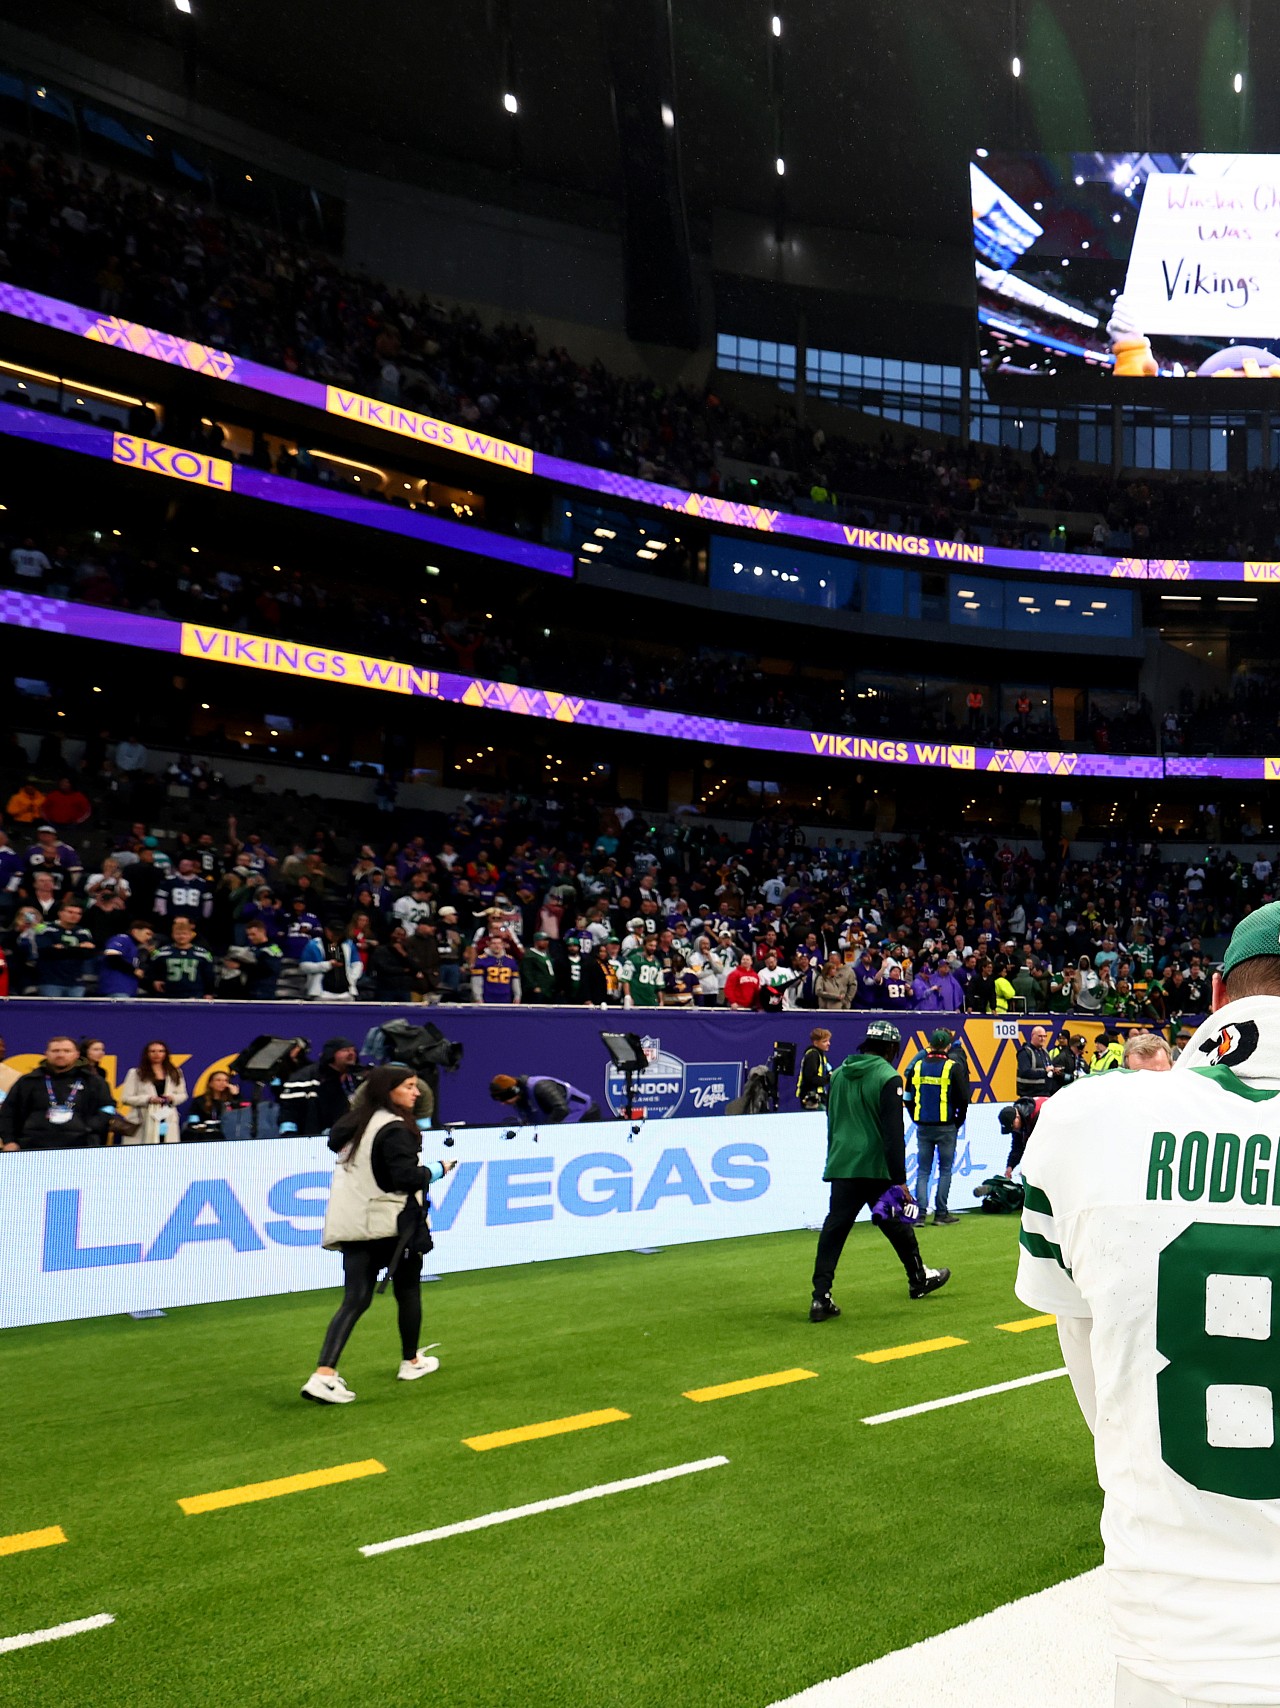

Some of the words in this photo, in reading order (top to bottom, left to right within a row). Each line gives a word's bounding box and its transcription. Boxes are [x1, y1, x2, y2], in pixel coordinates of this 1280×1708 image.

[1161, 257, 1259, 308] Vikings
[335, 390, 456, 446] VIKINGS
[463, 434, 530, 471] WIN!
[116, 434, 226, 488] SKOL
[843, 525, 930, 557] VIKINGS
[935, 539, 985, 564] WIN!
[193, 628, 347, 677] VIKINGS
[361, 659, 440, 697] WIN!
[810, 733, 908, 763] VIKINGS
[914, 743, 971, 768] WIN!
[171, 888, 200, 907] 88
[924, 908, 935, 919] 24
[166, 958, 200, 982] 54
[486, 967, 512, 984] 22
[570, 964, 581, 981] 5
[1061, 982, 1072, 997] 8
[995, 1024, 1016, 1035] 108
[42, 1171, 333, 1273] LAS
[428, 1142, 771, 1232] VEGAS
